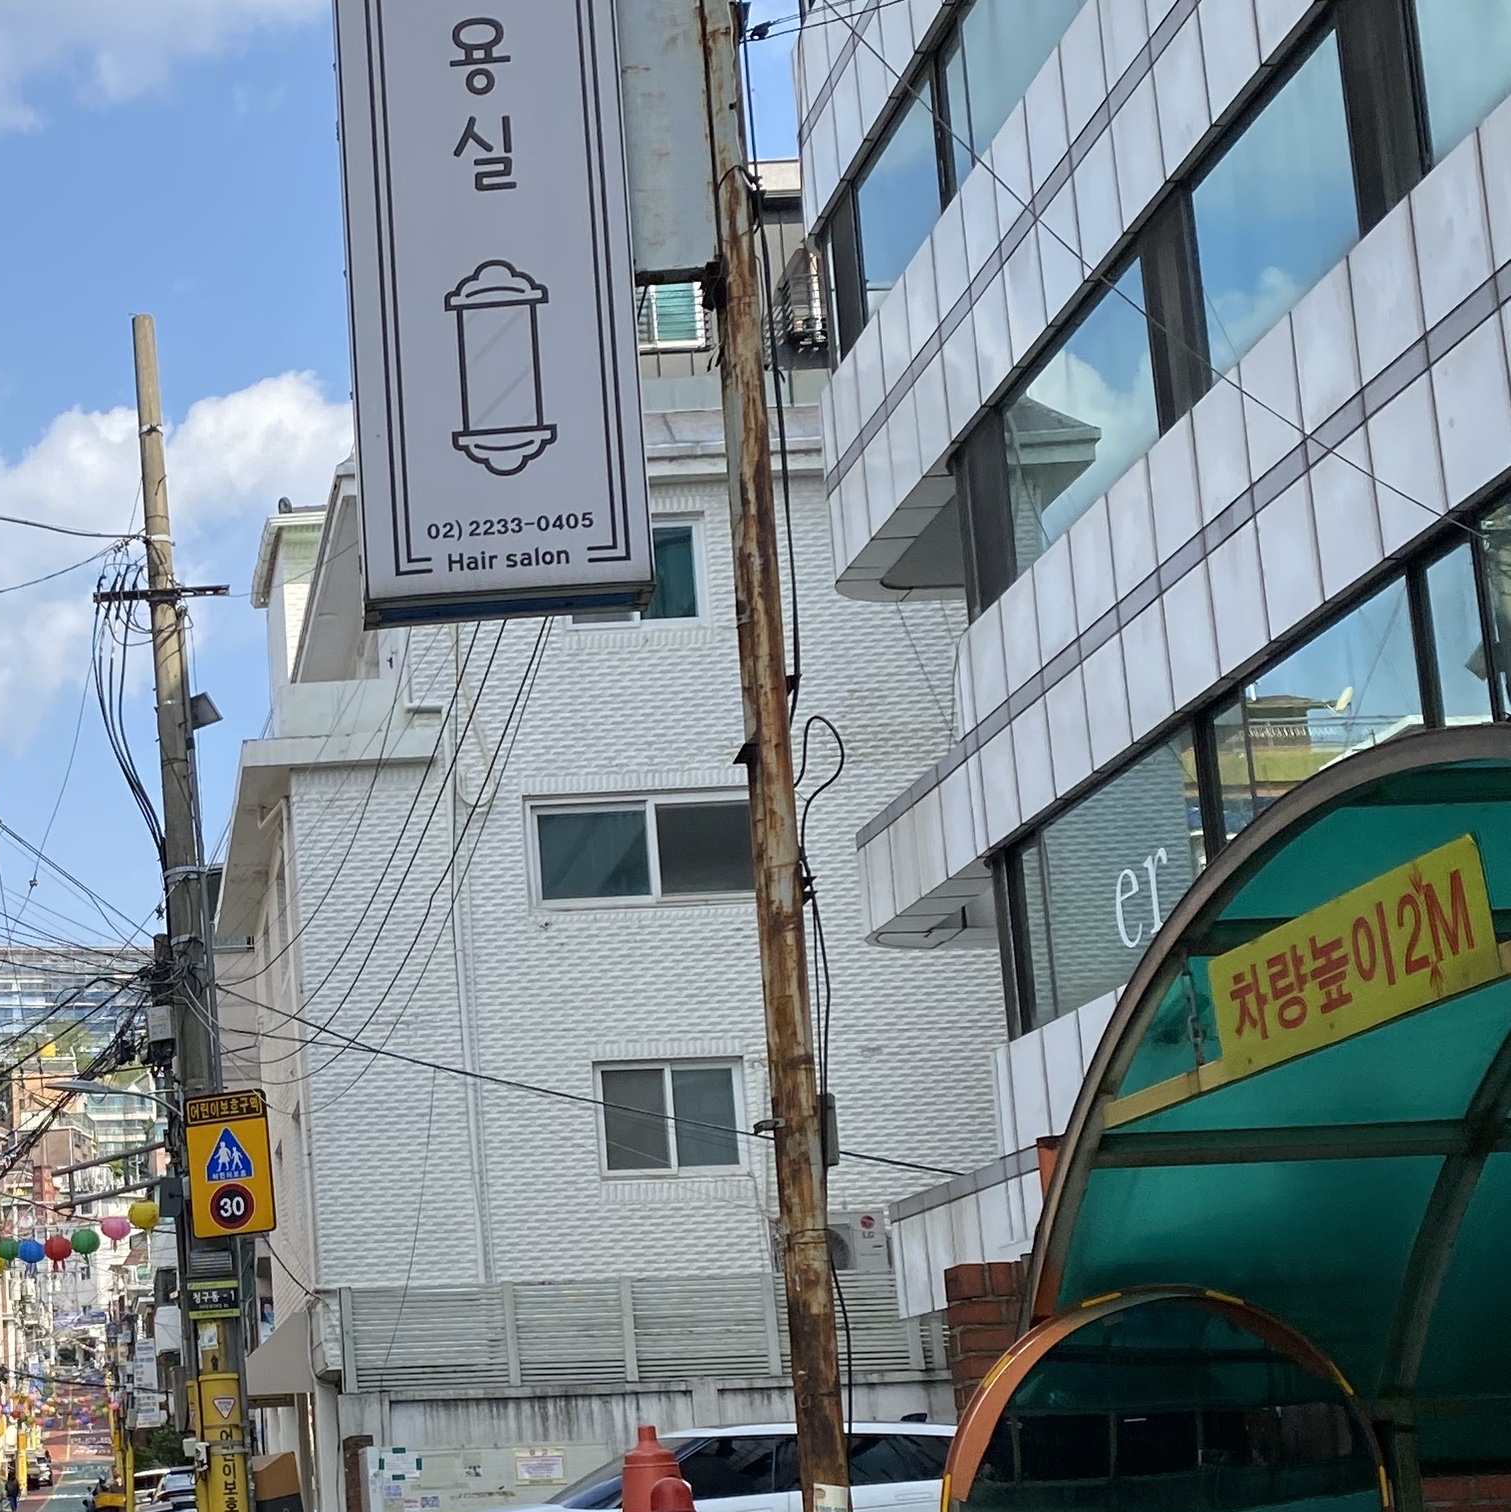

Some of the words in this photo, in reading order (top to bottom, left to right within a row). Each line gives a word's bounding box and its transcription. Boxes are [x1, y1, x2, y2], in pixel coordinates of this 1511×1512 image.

[448, 549, 498, 572] Hair
[506, 546, 570, 568] salon
[1116, 847, 1168, 949] er
[190, 1097, 260, 1119] 어린이보호구역
[219, 1196, 245, 1218] 30
